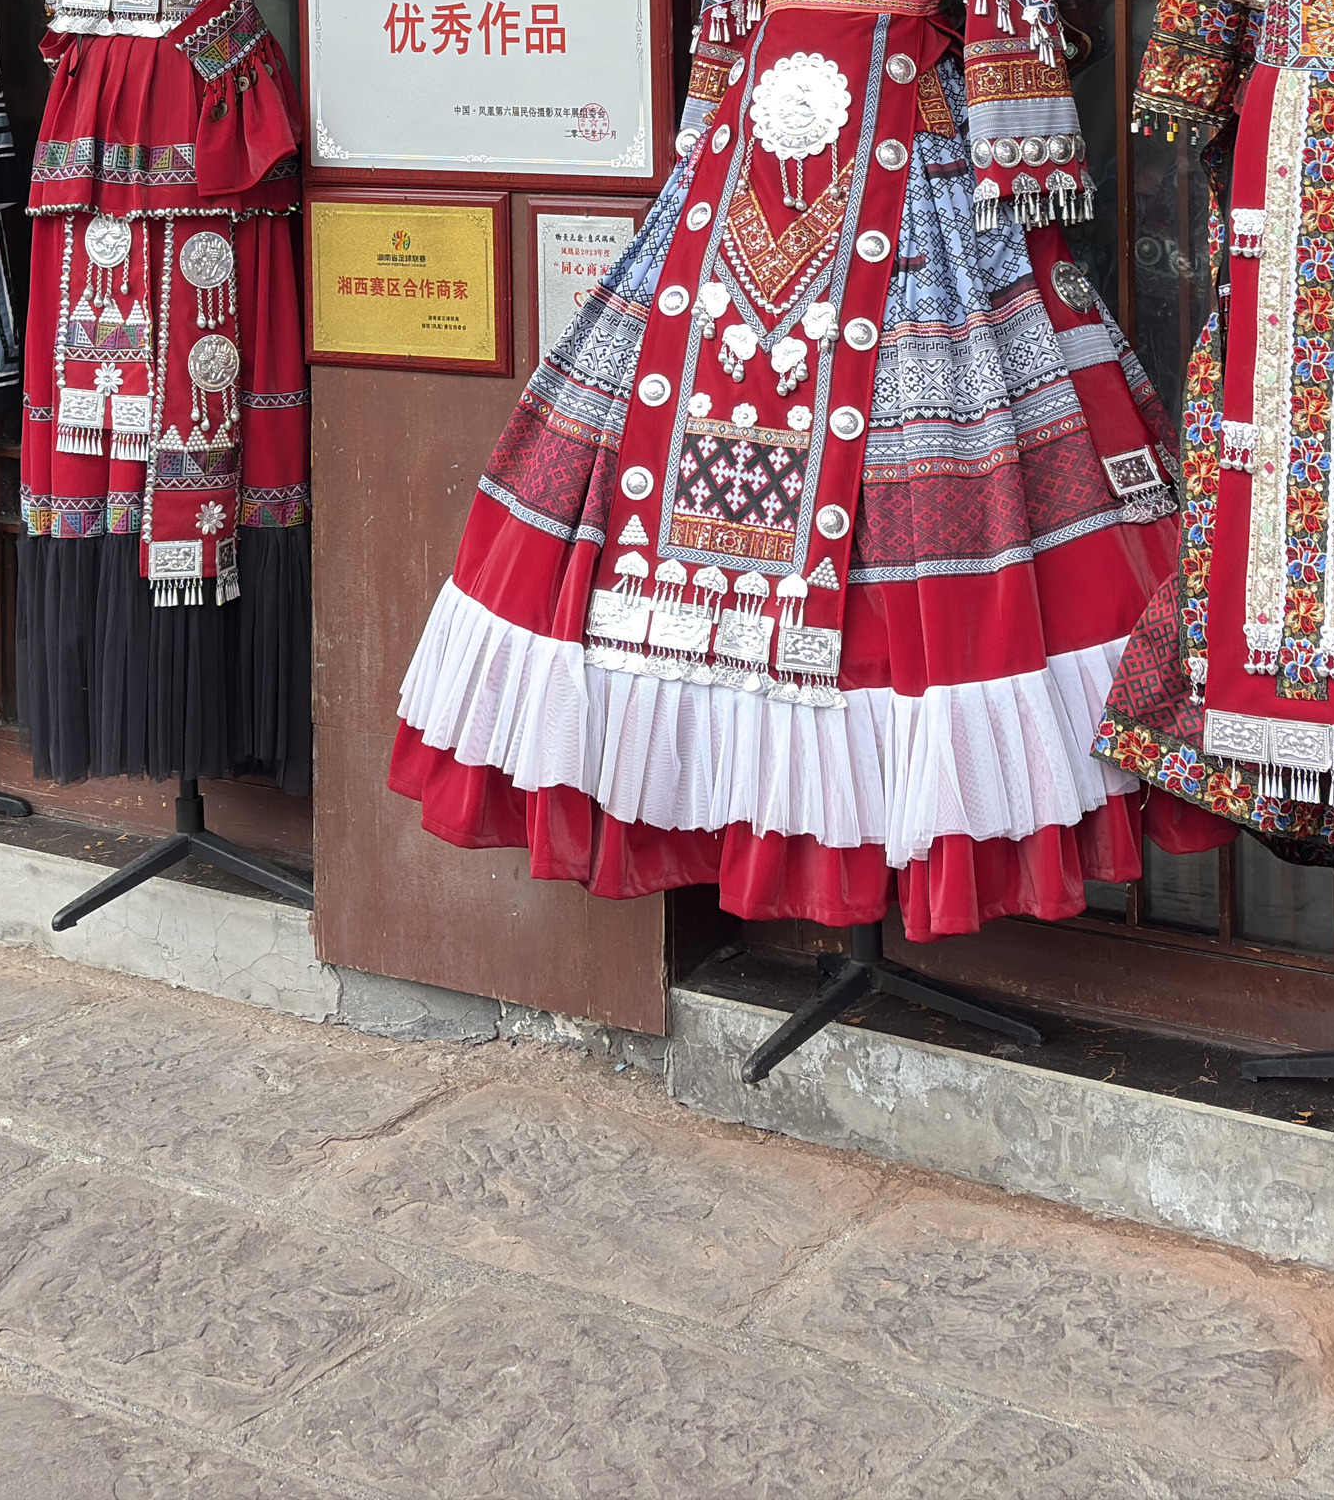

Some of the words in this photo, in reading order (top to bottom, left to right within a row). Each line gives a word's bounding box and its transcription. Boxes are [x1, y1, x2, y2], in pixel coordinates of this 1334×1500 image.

[384, 1, 567, 56] 优秀作品
[337, 276, 469, 300] 湘西赛区合作商家
